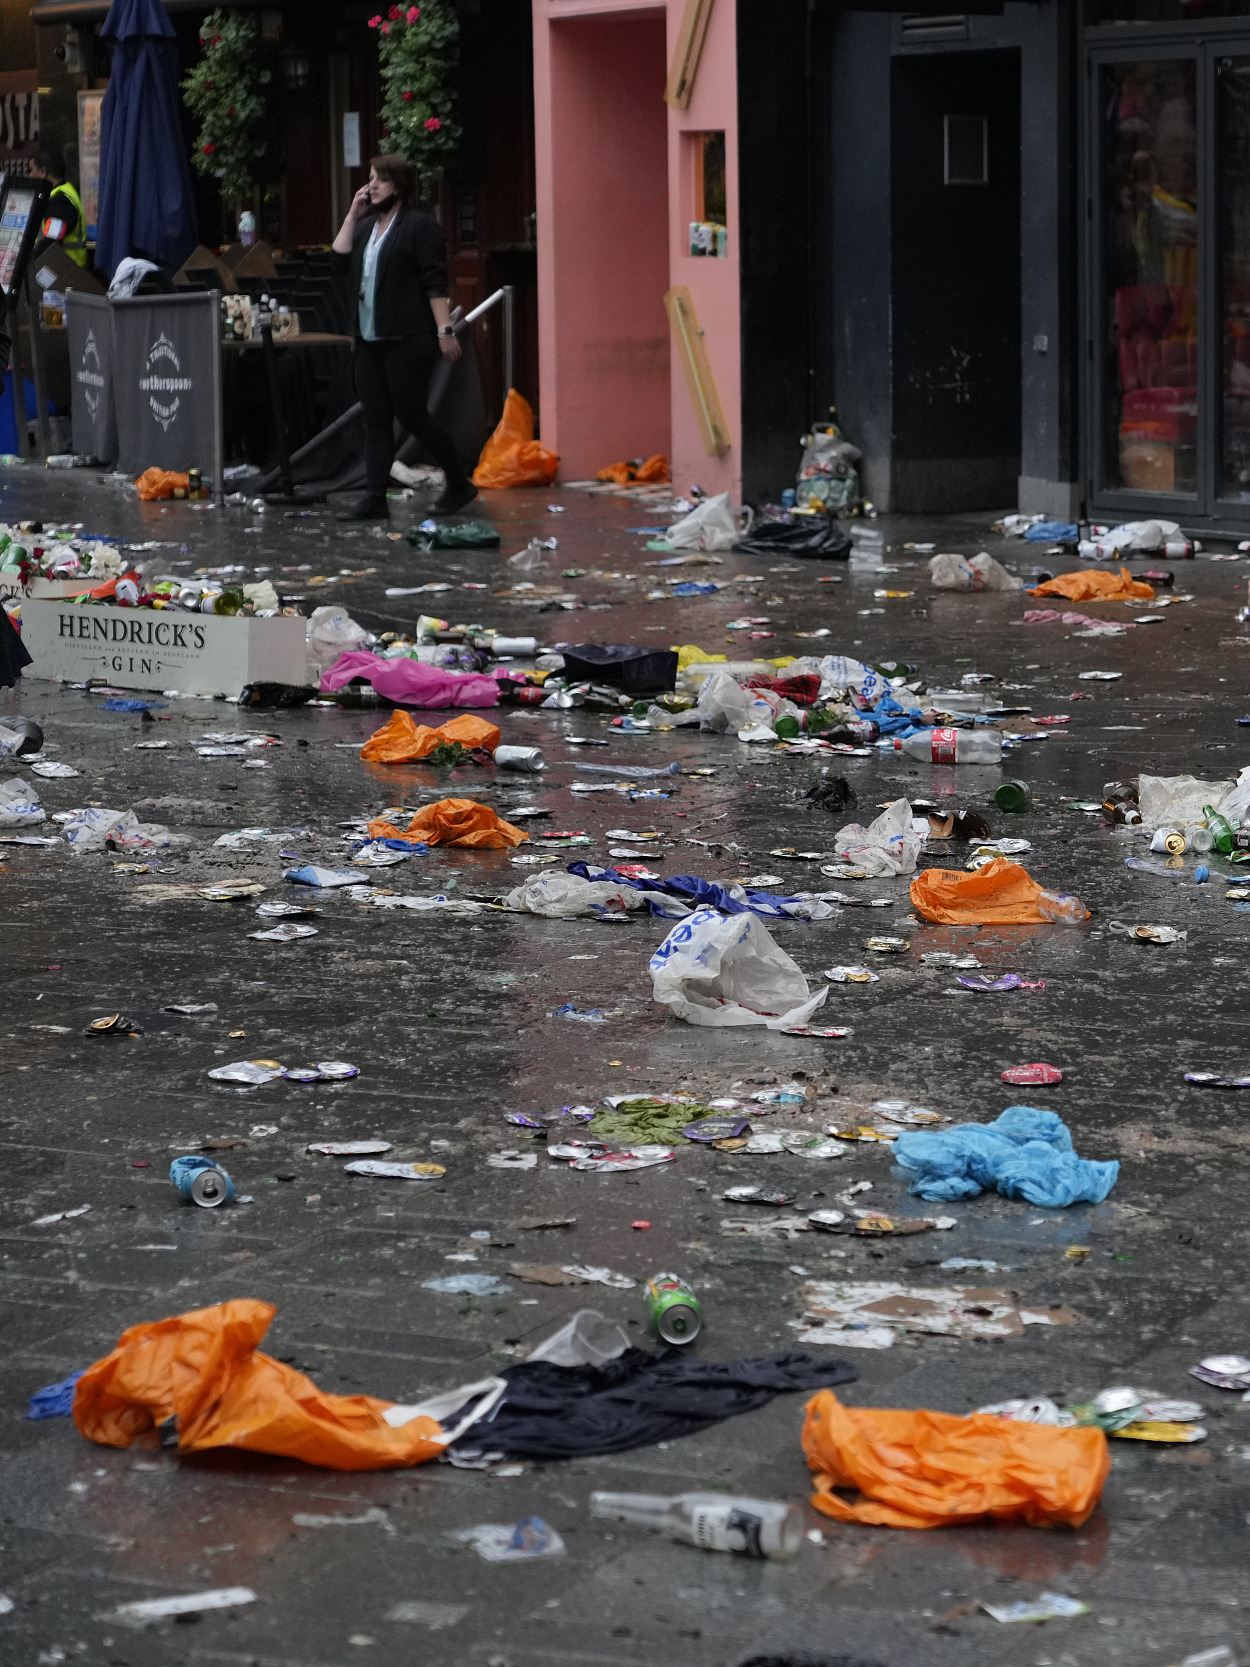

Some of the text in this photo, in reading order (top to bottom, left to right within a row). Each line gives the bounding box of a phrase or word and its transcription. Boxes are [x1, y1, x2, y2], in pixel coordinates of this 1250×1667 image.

[58, 614, 205, 649] HENDRICK'S
[64, 642, 102, 651] DISTILLED
[117, 647, 149, 655] BOTTLED
[163, 652, 200, 660] SCOTLAND
[111, 655, 152, 674] GIN
